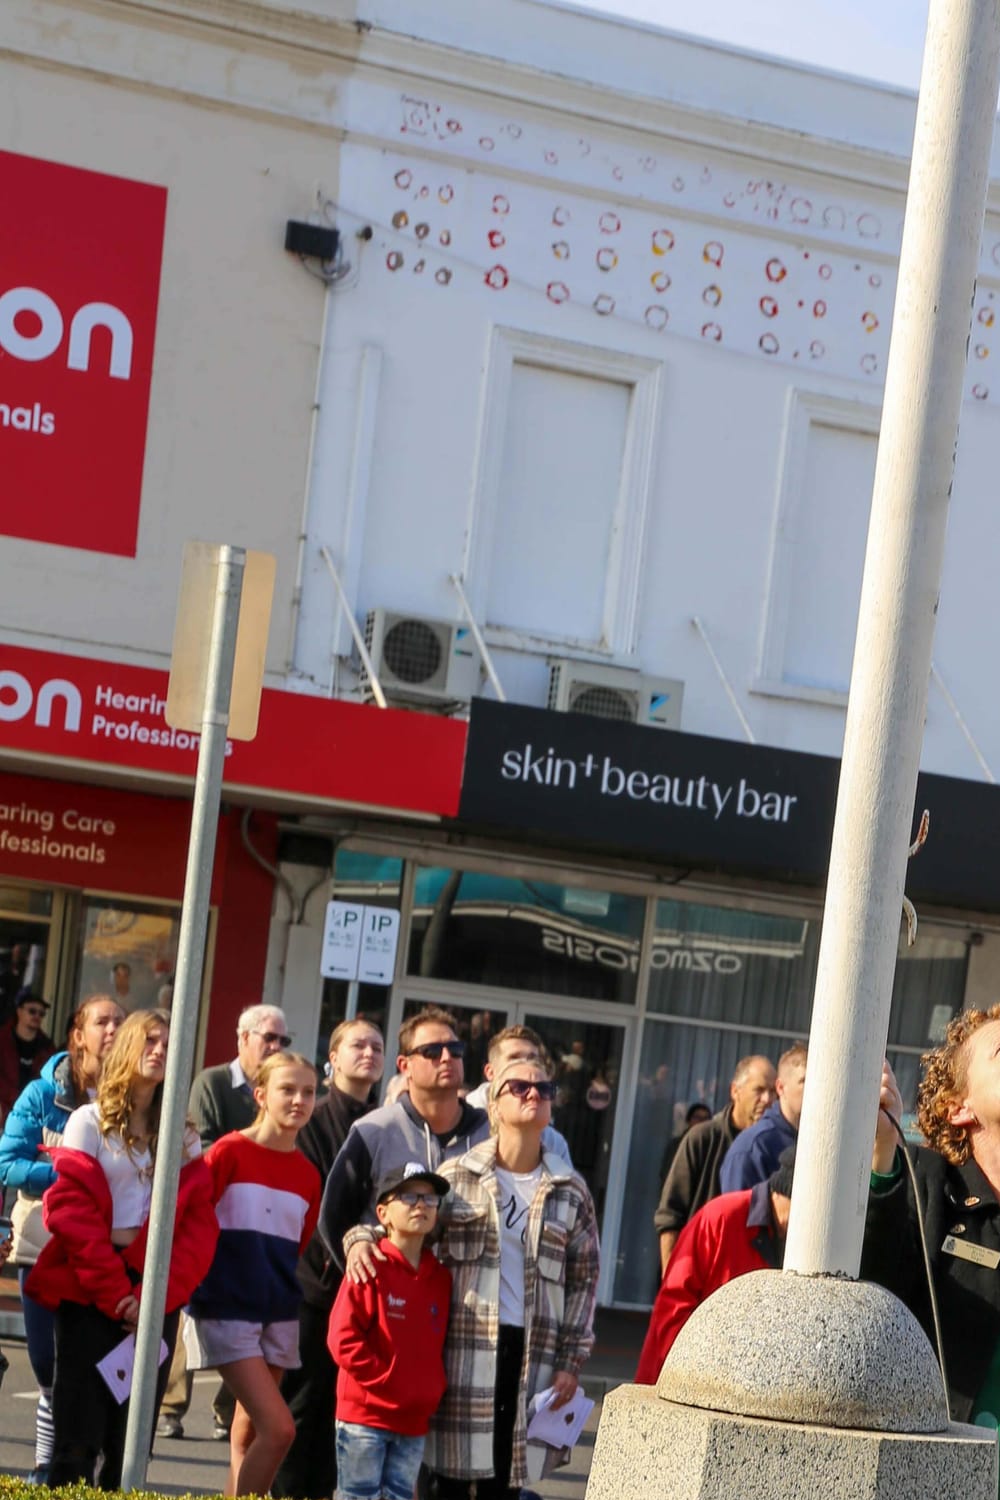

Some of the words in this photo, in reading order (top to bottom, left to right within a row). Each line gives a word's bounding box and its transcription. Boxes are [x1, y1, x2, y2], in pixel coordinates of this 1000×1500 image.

[94, 685, 168, 716] Hearin
[736, 778, 797, 822] bar
[62, 809, 116, 836] Care
[371, 914, 392, 933] 1P
